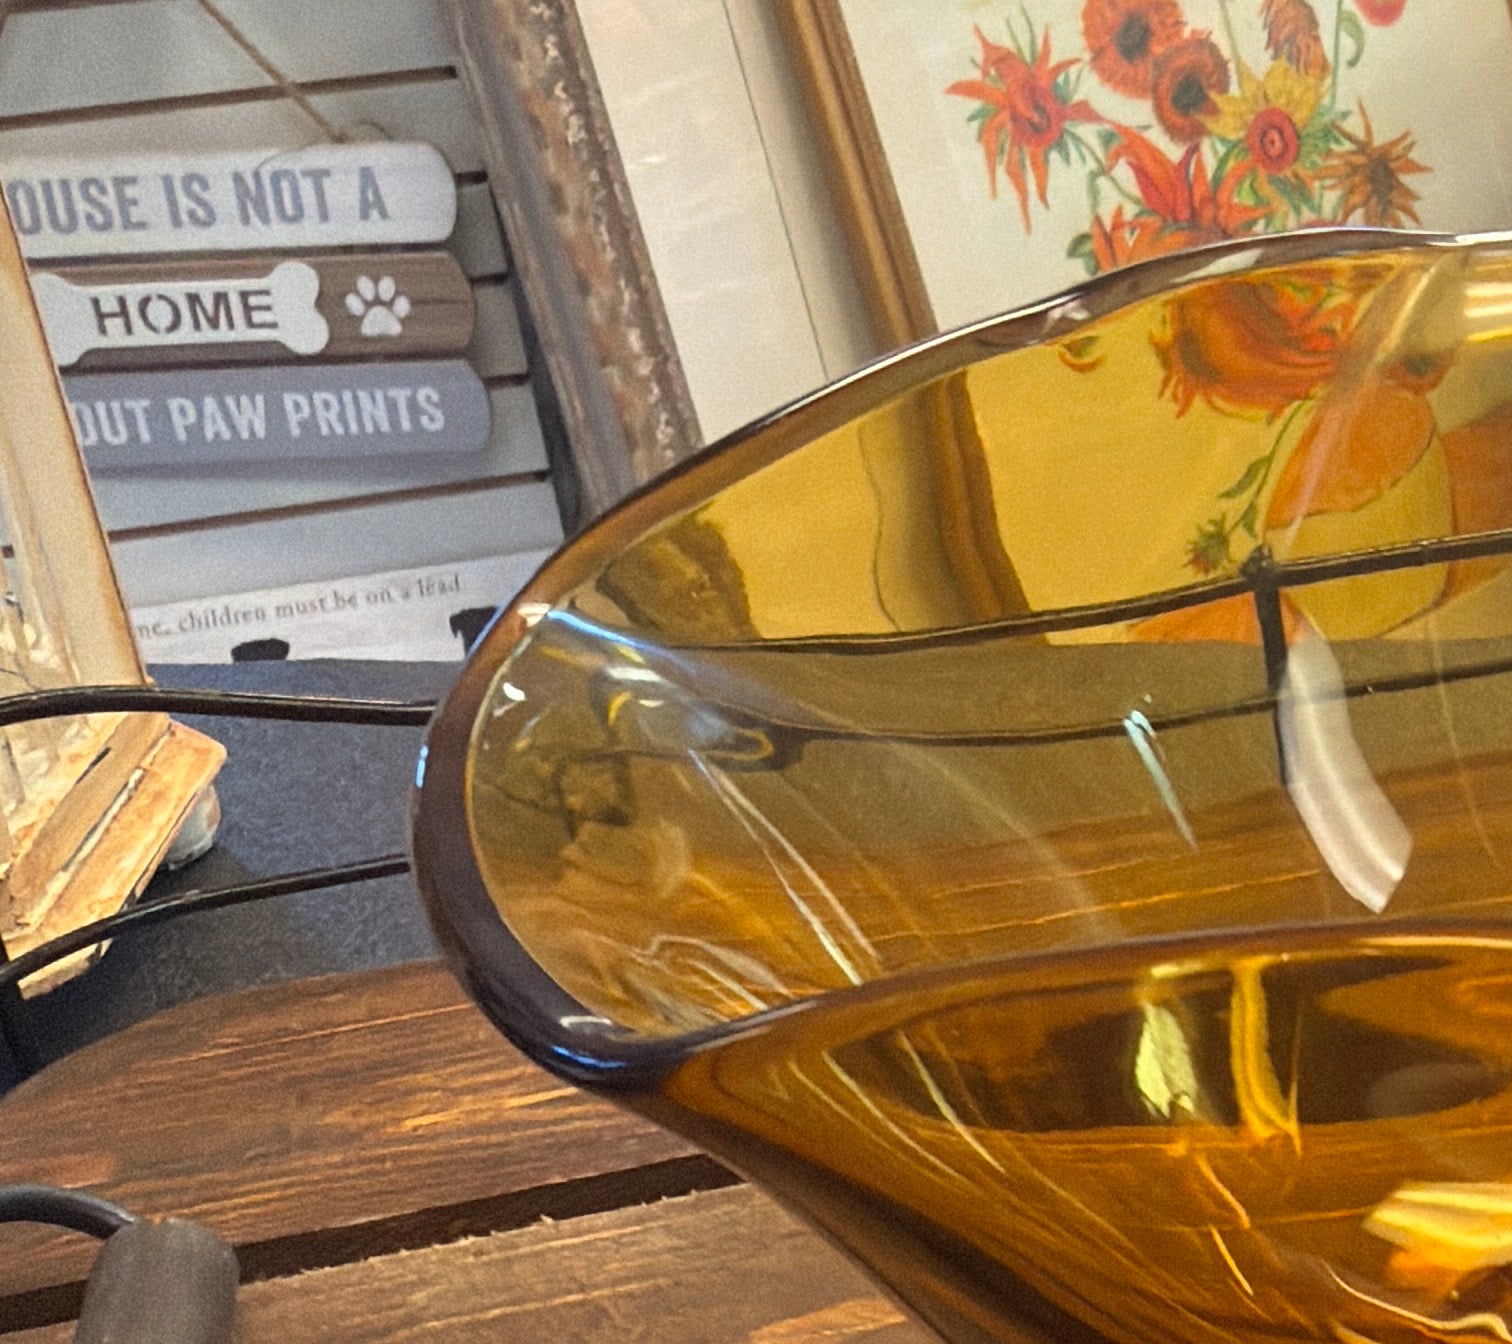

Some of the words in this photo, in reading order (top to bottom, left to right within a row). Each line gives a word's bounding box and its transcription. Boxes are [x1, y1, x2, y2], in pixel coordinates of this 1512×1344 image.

[161, 172, 217, 228] IS
[231, 168, 332, 227] NOT
[358, 166, 391, 222] A
[90, 288, 279, 336] HOME
[166, 393, 266, 443] PAW
[282, 386, 445, 439] PRINTS
[178, 605, 266, 633] children
[274, 595, 330, 619] must
[332, 588, 359, 610] be
[364, 586, 394, 604] on
